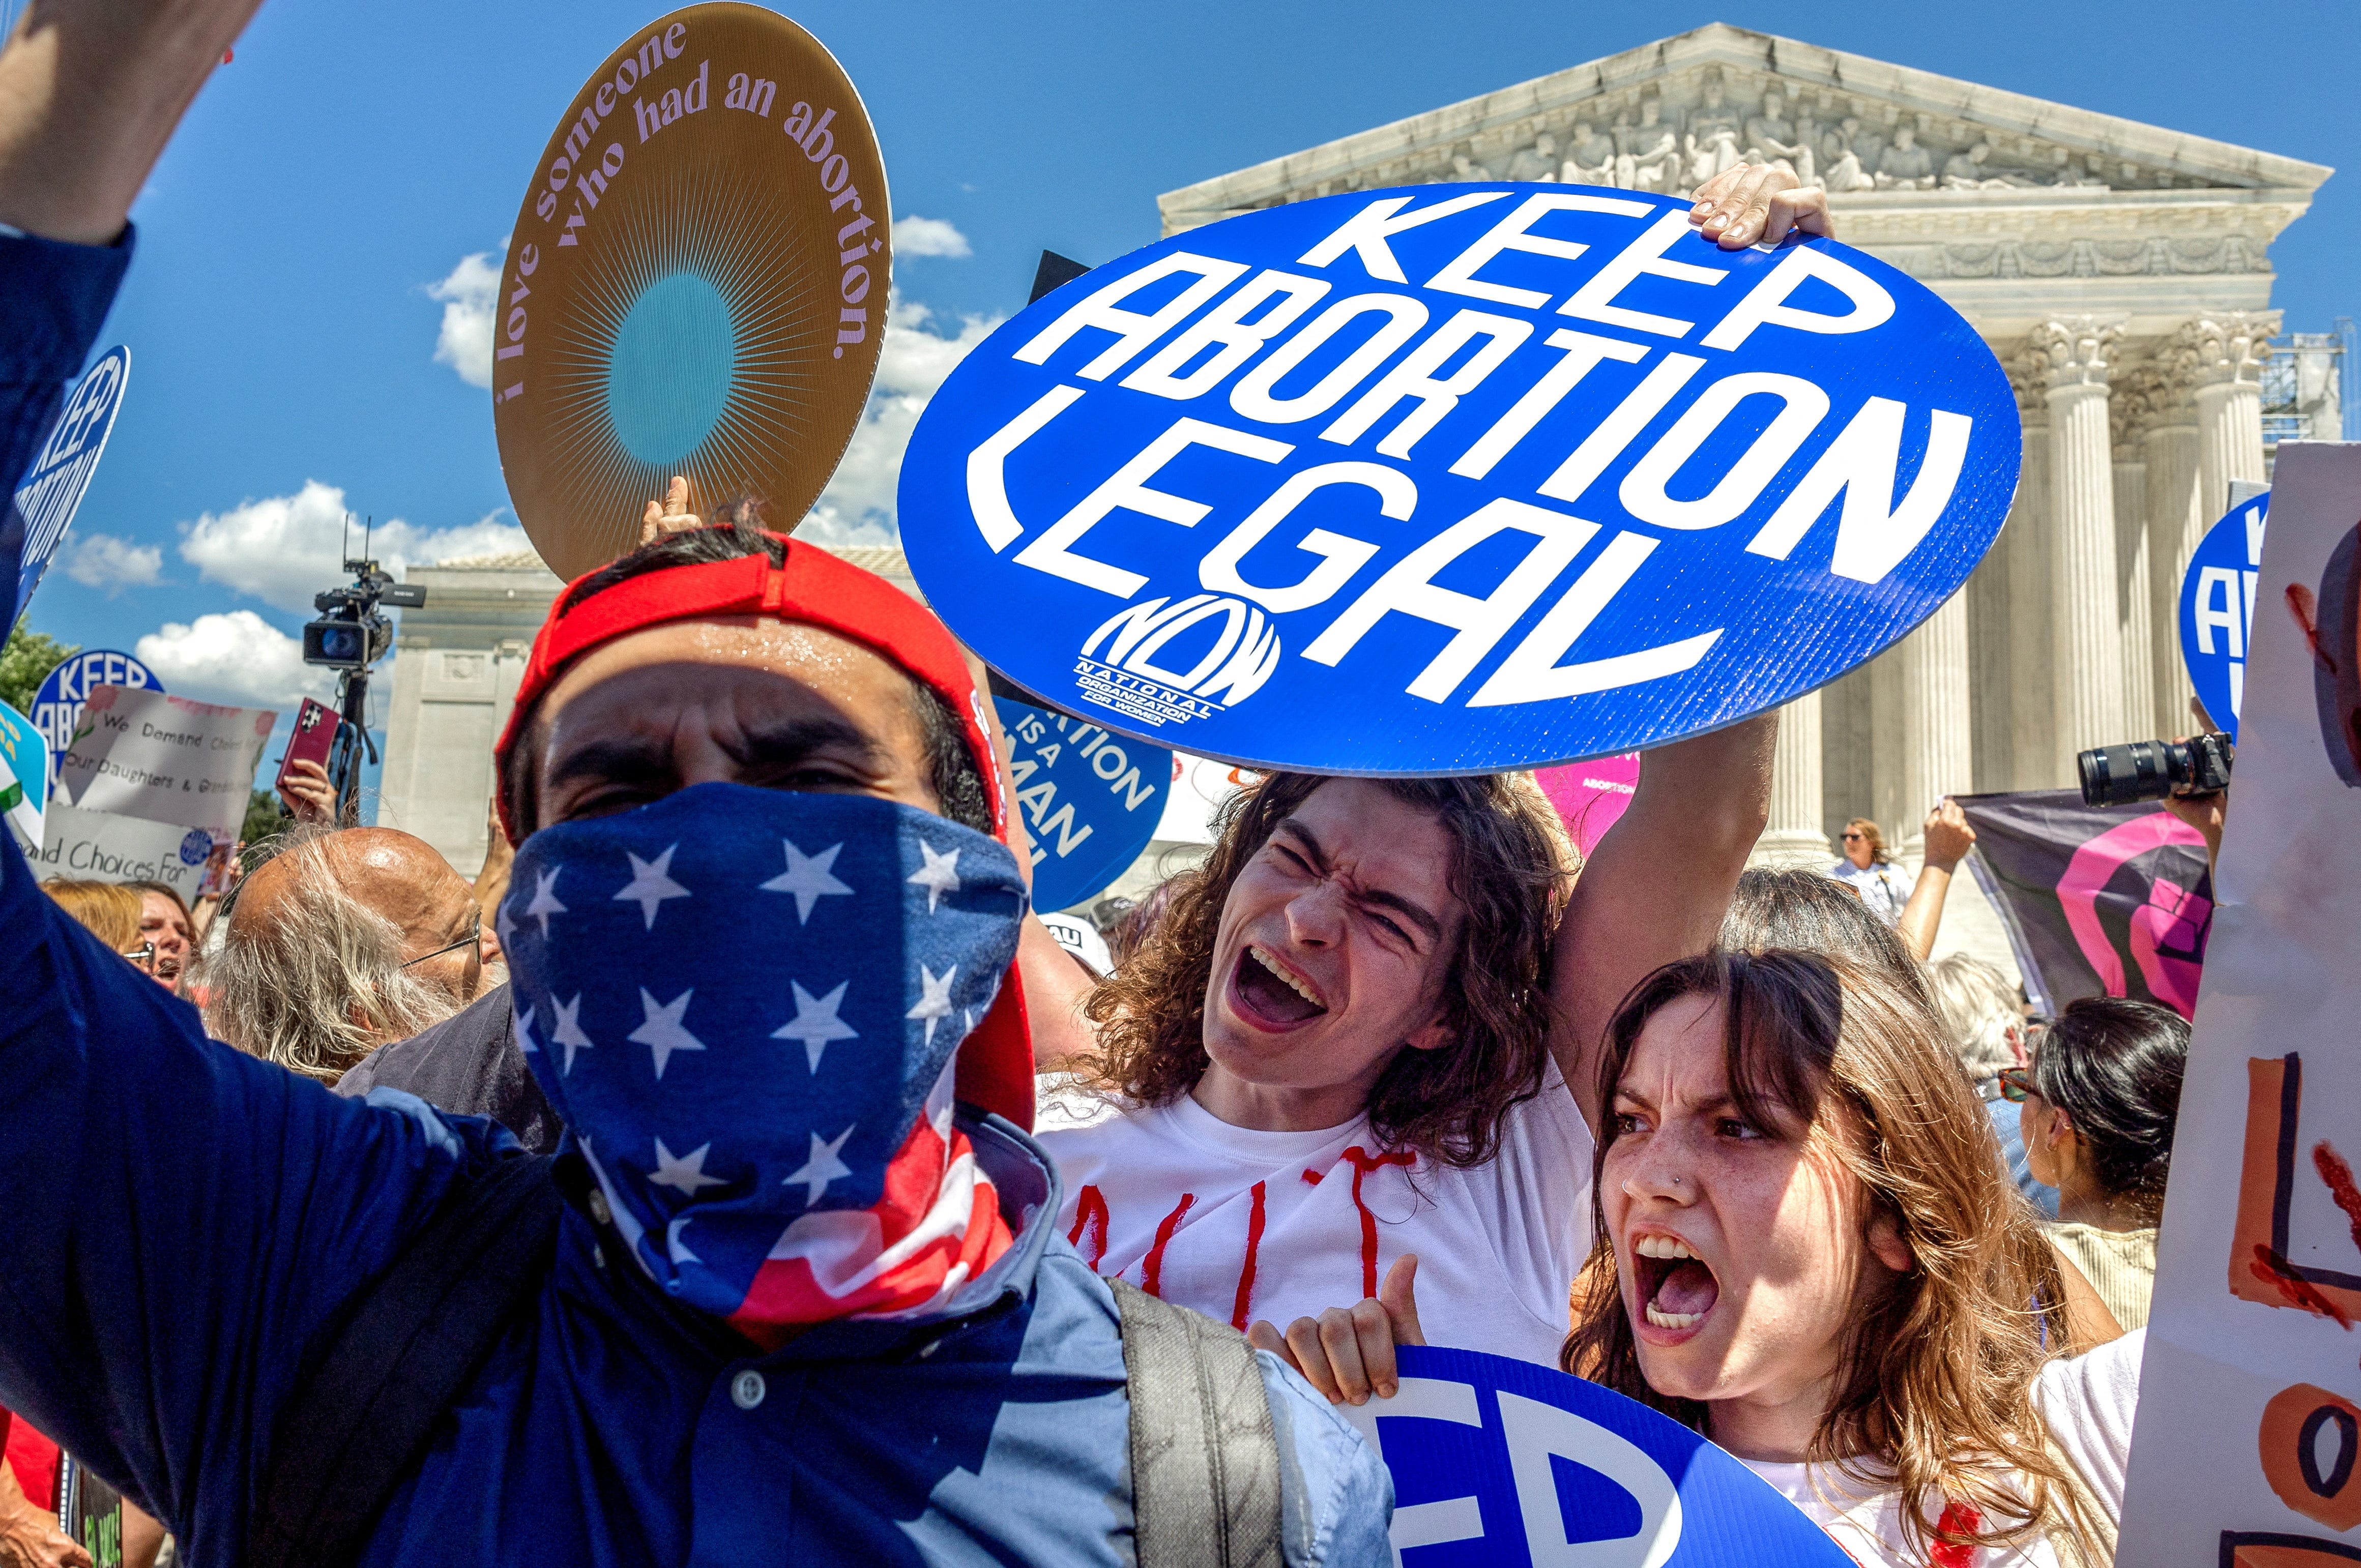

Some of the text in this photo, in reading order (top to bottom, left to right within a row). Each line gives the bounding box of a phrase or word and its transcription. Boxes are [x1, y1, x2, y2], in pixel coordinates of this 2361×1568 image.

[496, 22, 687, 404] i love someone
[557, 58, 884, 361] who had an abortion.
[1295, 191, 1896, 352] KEEP
[1011, 250, 1973, 584] ABORTION
[15, 445, 99, 570] TION
[966, 383, 1725, 708] LEGAL
[1080, 594, 1281, 707] NOW
[2195, 566, 2259, 658] A
[59, 653, 148, 701] KEEP
[104, 713, 129, 733] We
[1075, 661, 1212, 717] NATIONAL
[1078, 675, 1192, 722] ORGANIZATION
[1084, 690, 1167, 725] FOR WOMEN
[97, 759, 173, 789] Daughters
[1015, 713, 1062, 768] IS A
[1046, 711, 1156, 812] TION
[1001, 724, 1094, 859] MAN
[17, 837, 64, 864] and
[69, 841, 155, 882] Choices
[159, 852, 187, 883] For
